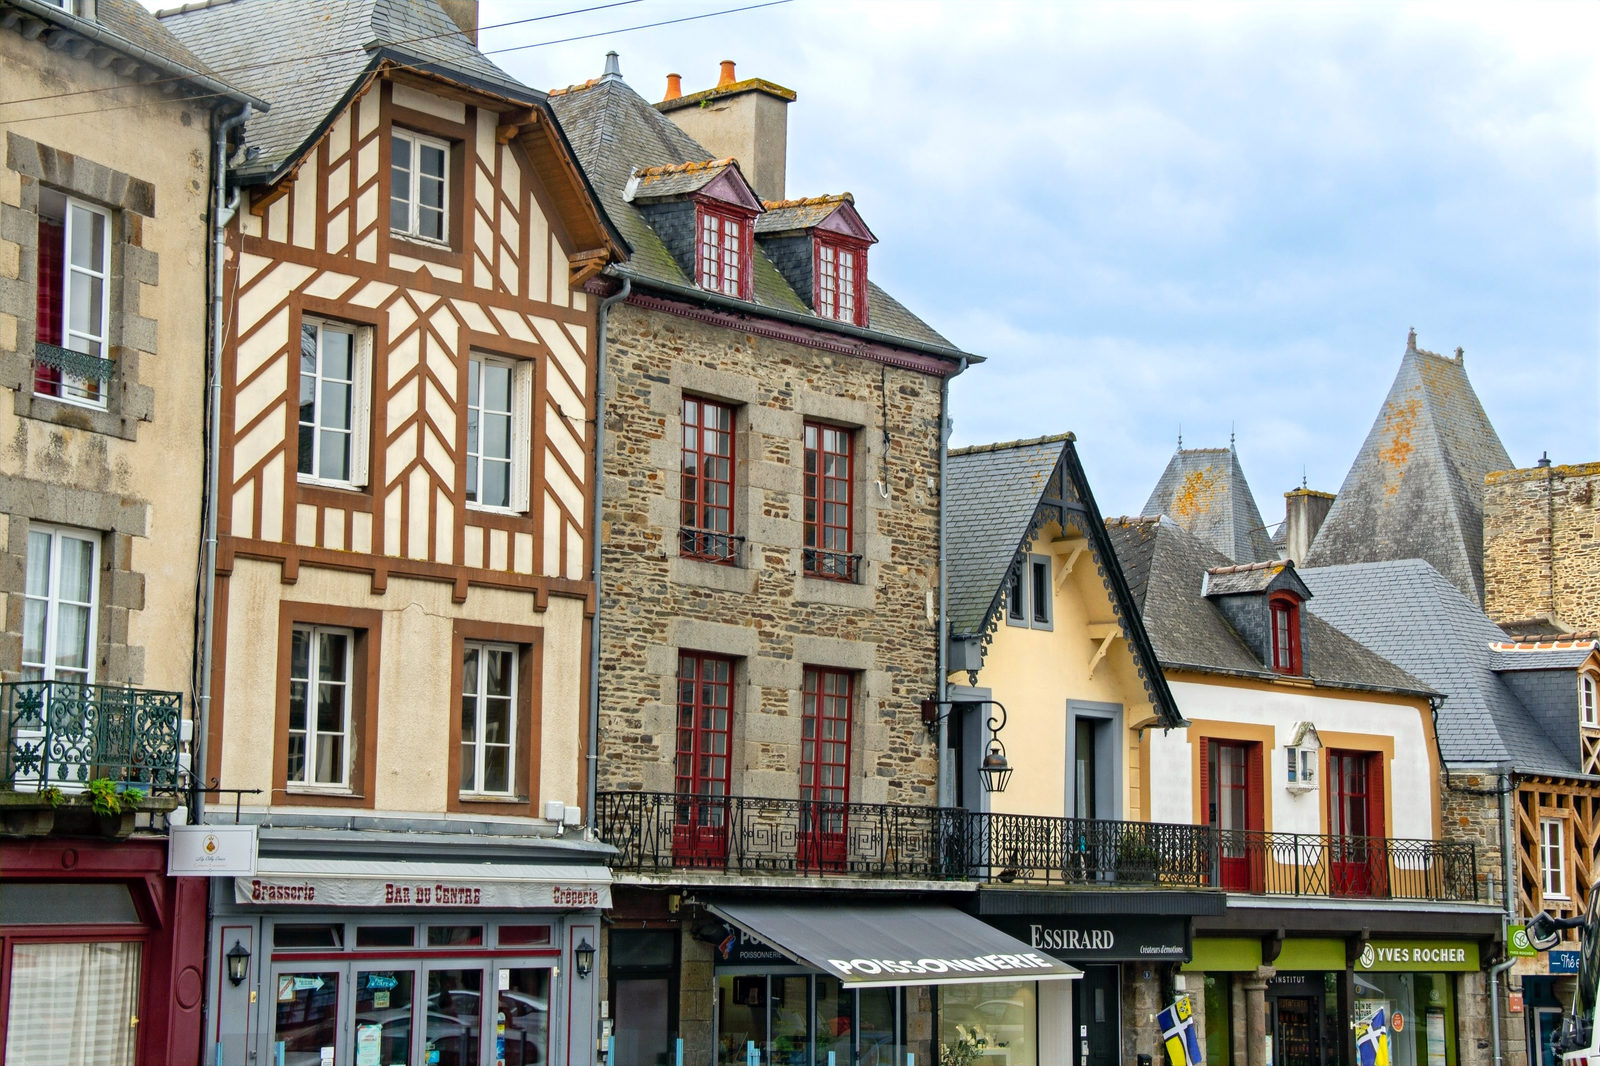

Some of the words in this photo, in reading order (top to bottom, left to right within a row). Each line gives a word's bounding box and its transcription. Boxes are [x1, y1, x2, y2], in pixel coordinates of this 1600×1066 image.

[252, 880, 315, 901] Brasserie
[385, 883, 411, 903] BAR
[415, 887, 431, 904] DU
[435, 884, 481, 905] CENTRE
[553, 886, 598, 906] Crêperie
[642, 920, 647, 929] 7
[1030, 924, 1115, 950] ESSIRARD
[740, 951, 782, 959] POISSONNERIE
[827, 953, 1054, 975] POISSONNERIE
[1377, 948, 1410, 962] YVES
[1412, 948, 1466, 962] ROCHER
[1560, 953, 1575, 968] Thé
